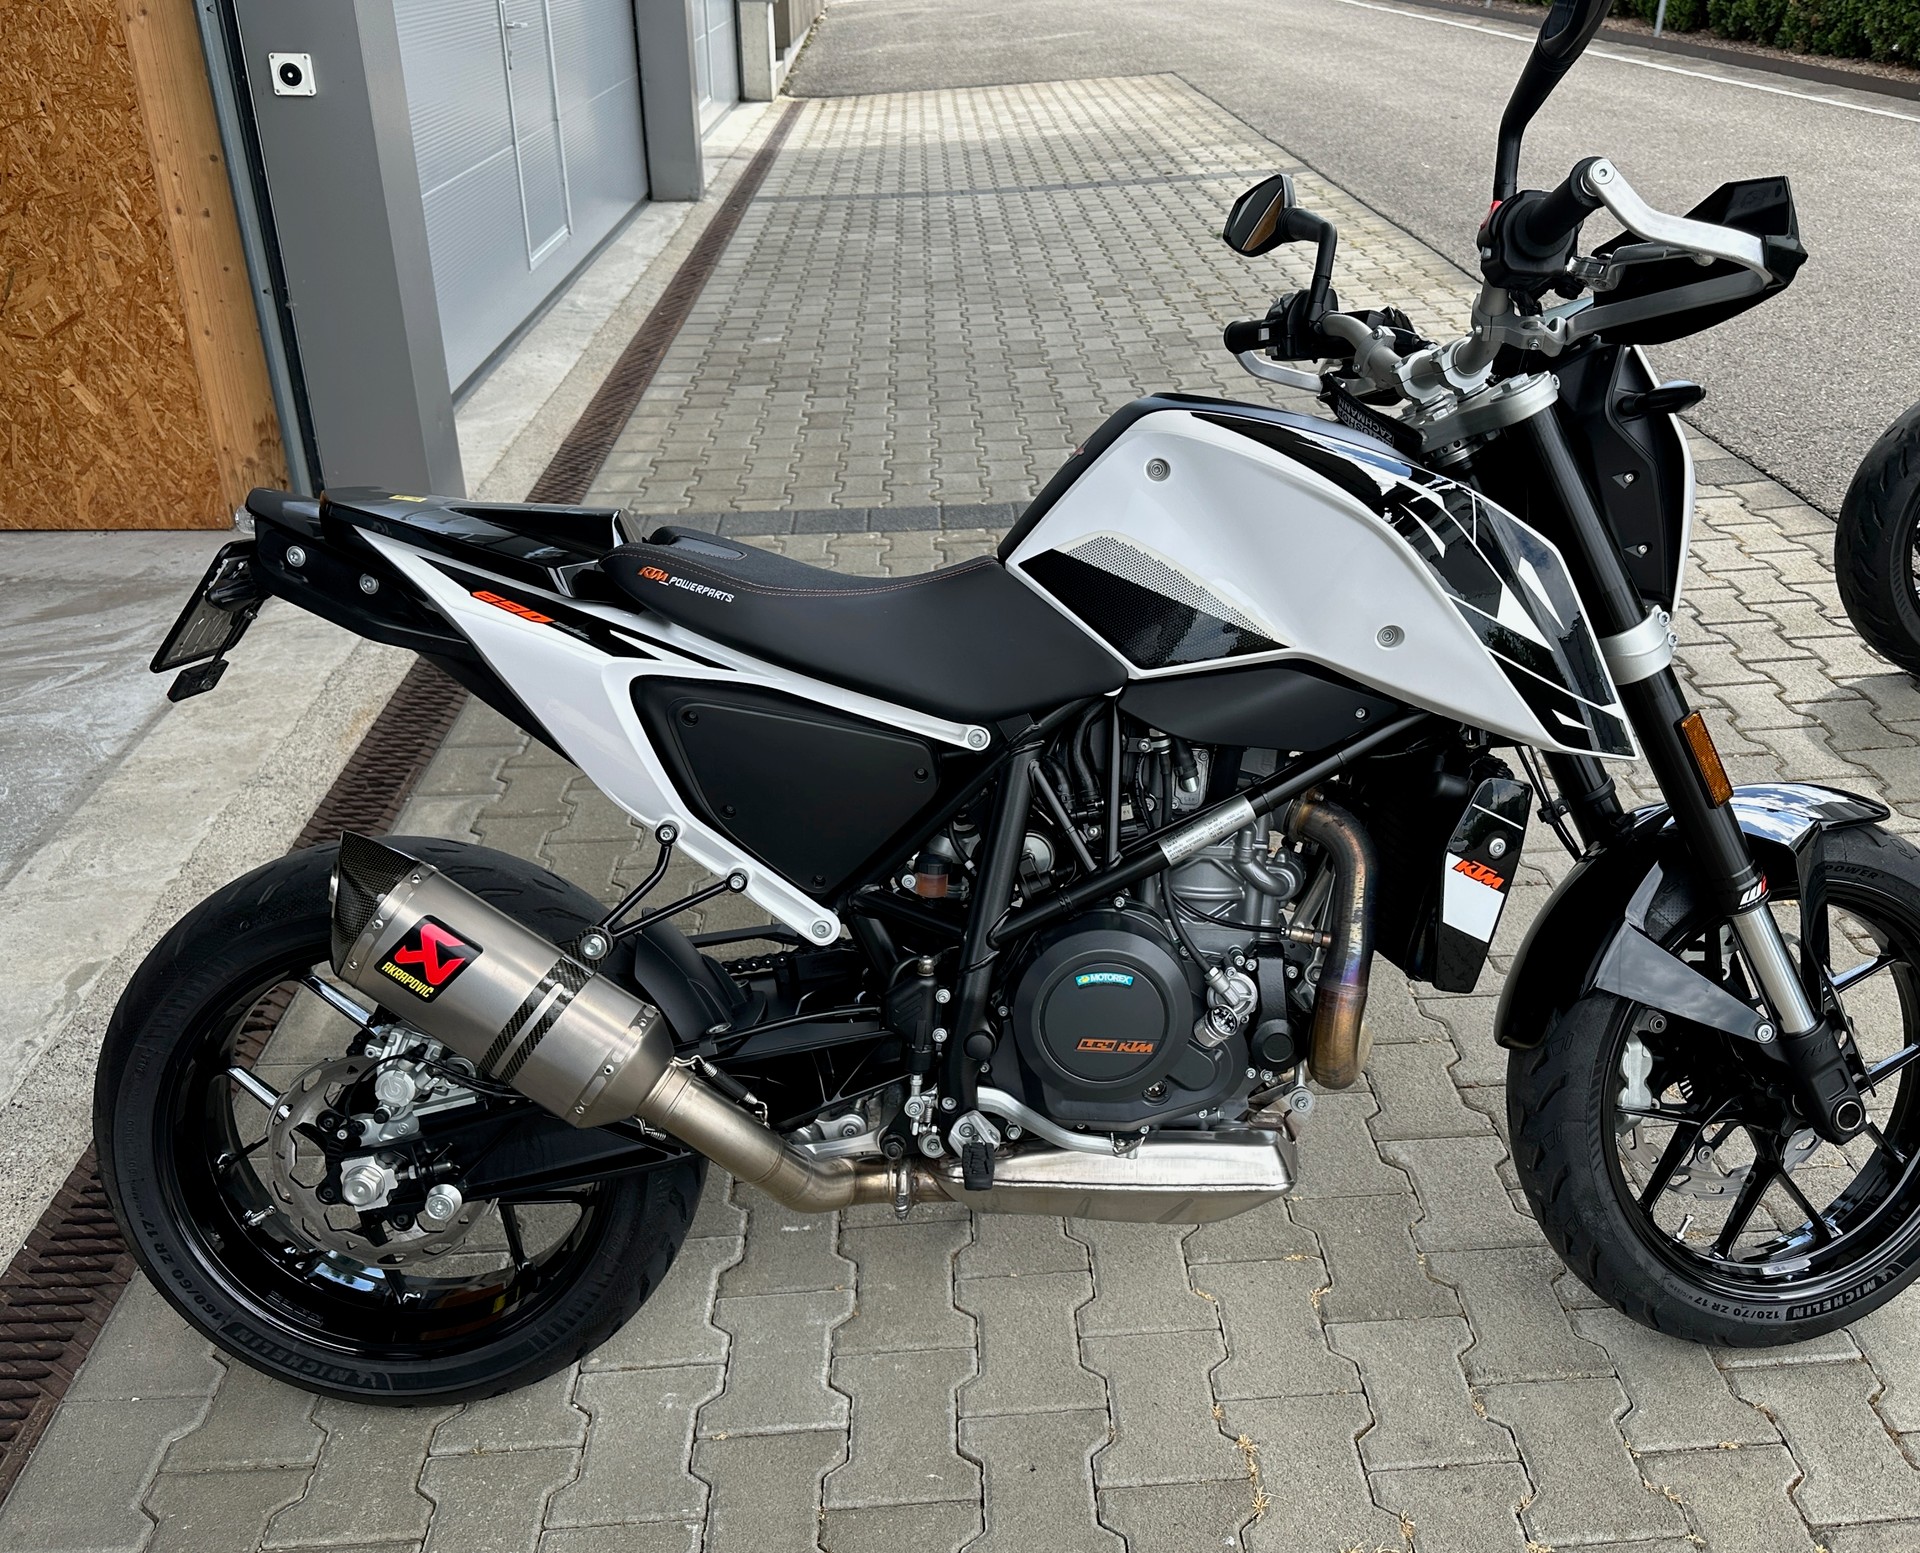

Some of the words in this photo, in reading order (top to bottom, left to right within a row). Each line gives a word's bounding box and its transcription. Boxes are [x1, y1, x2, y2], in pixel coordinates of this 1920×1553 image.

[1338, 407, 1394, 447] OTOSHOP
[637, 566, 670, 582] KTM
[668, 576, 735, 603] POWERPARTS
[472, 591, 556, 622] 690
[1453, 859, 1504, 889] KTM
[1090, 973, 1130, 984] MOTOREX
[1117, 1040, 1154, 1053] KTM
[172, 1269, 224, 1319] 160/60
[1694, 1297, 1709, 1308] 17
[1711, 1302, 1730, 1314] ZR
[1792, 1281, 1876, 1319] MICHELIN
[1733, 1308, 1780, 1320] 120/70
[232, 1328, 348, 1382] MICHELIN
